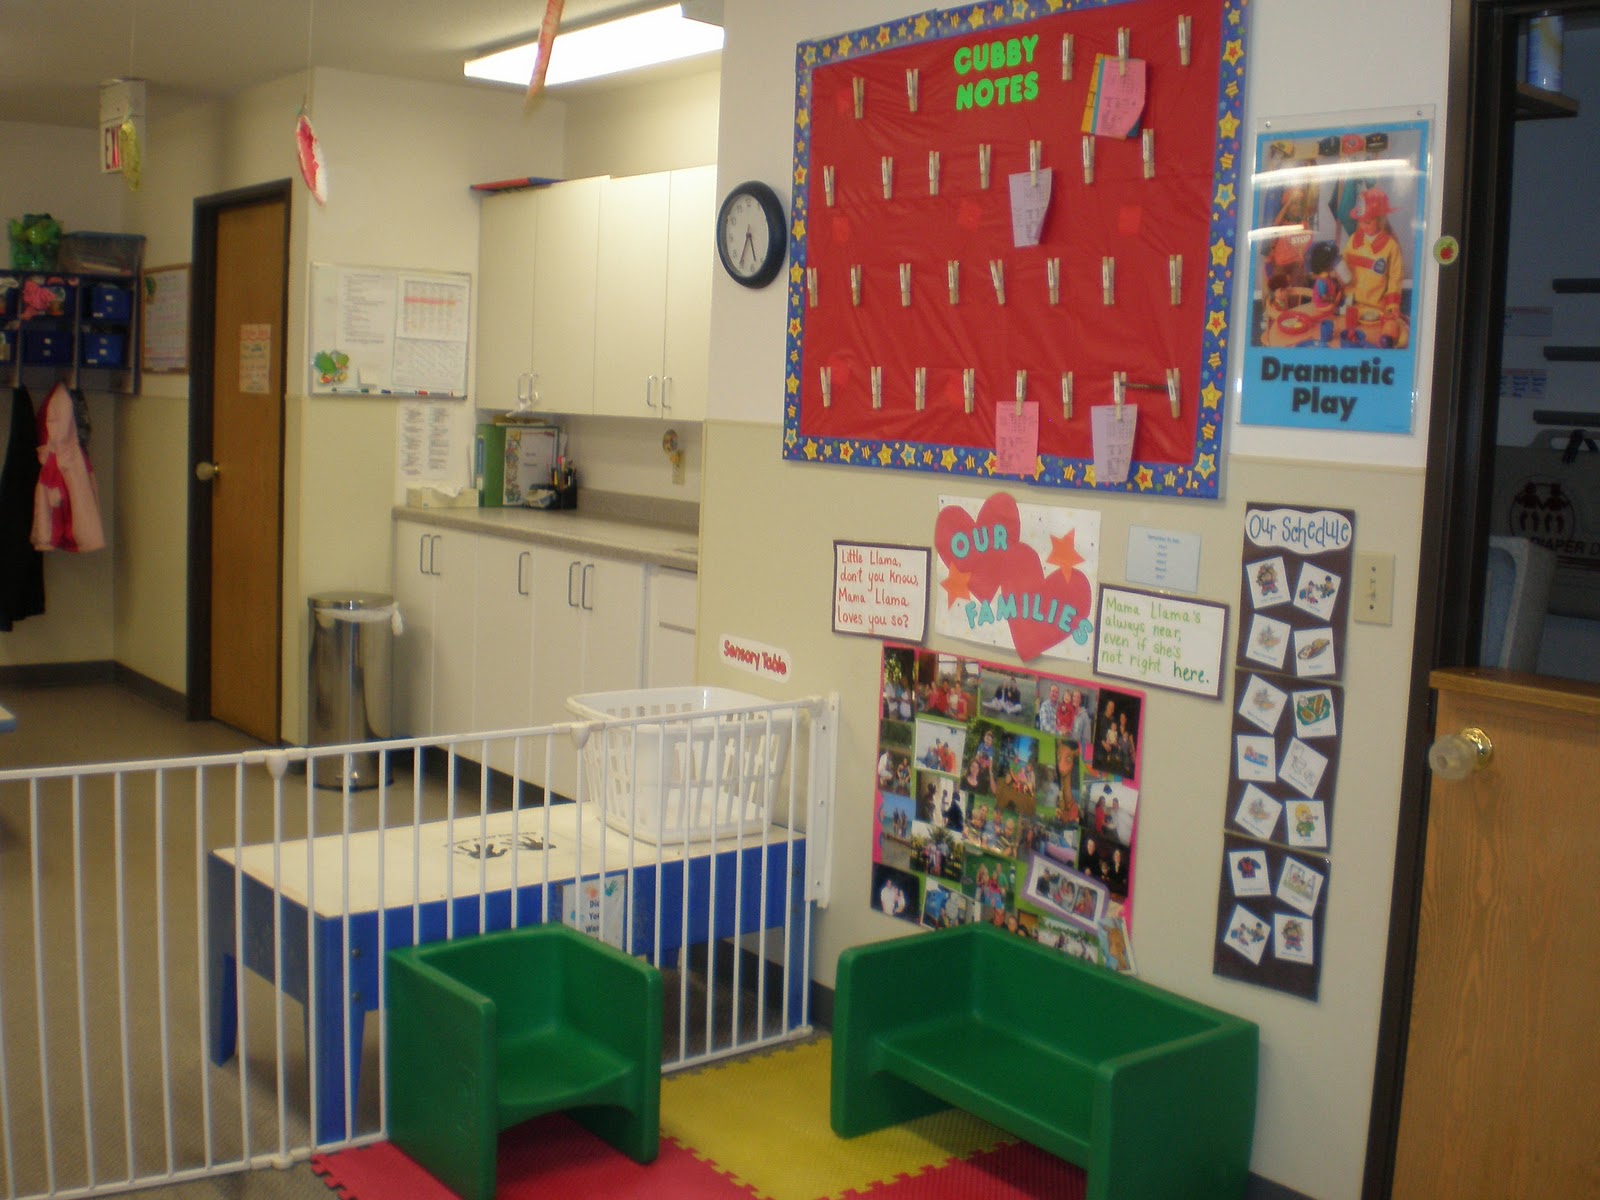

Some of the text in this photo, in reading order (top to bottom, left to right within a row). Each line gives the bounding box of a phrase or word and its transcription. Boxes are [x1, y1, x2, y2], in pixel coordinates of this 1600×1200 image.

[954, 34, 1039, 74] CUBBY
[956, 71, 1039, 111] NOTES
[1261, 356, 1395, 385] Dramatic
[1291, 386, 1358, 422] Play
[951, 524, 1008, 558] OUR
[1249, 514, 1349, 548] Our Schedule
[841, 548, 901, 567] Little Llama,
[840, 566, 863, 583] don't
[868, 572, 885, 592] you
[838, 587, 865, 603] Mama
[868, 614, 887, 634] you
[891, 614, 909, 628] so?
[965, 594, 1093, 646] FAMILIES
[1105, 597, 1201, 624] Mama Llama's
[1105, 614, 1181, 642] always near,
[1103, 632, 1181, 659] even if she's
[1101, 650, 1209, 683] not right here.
